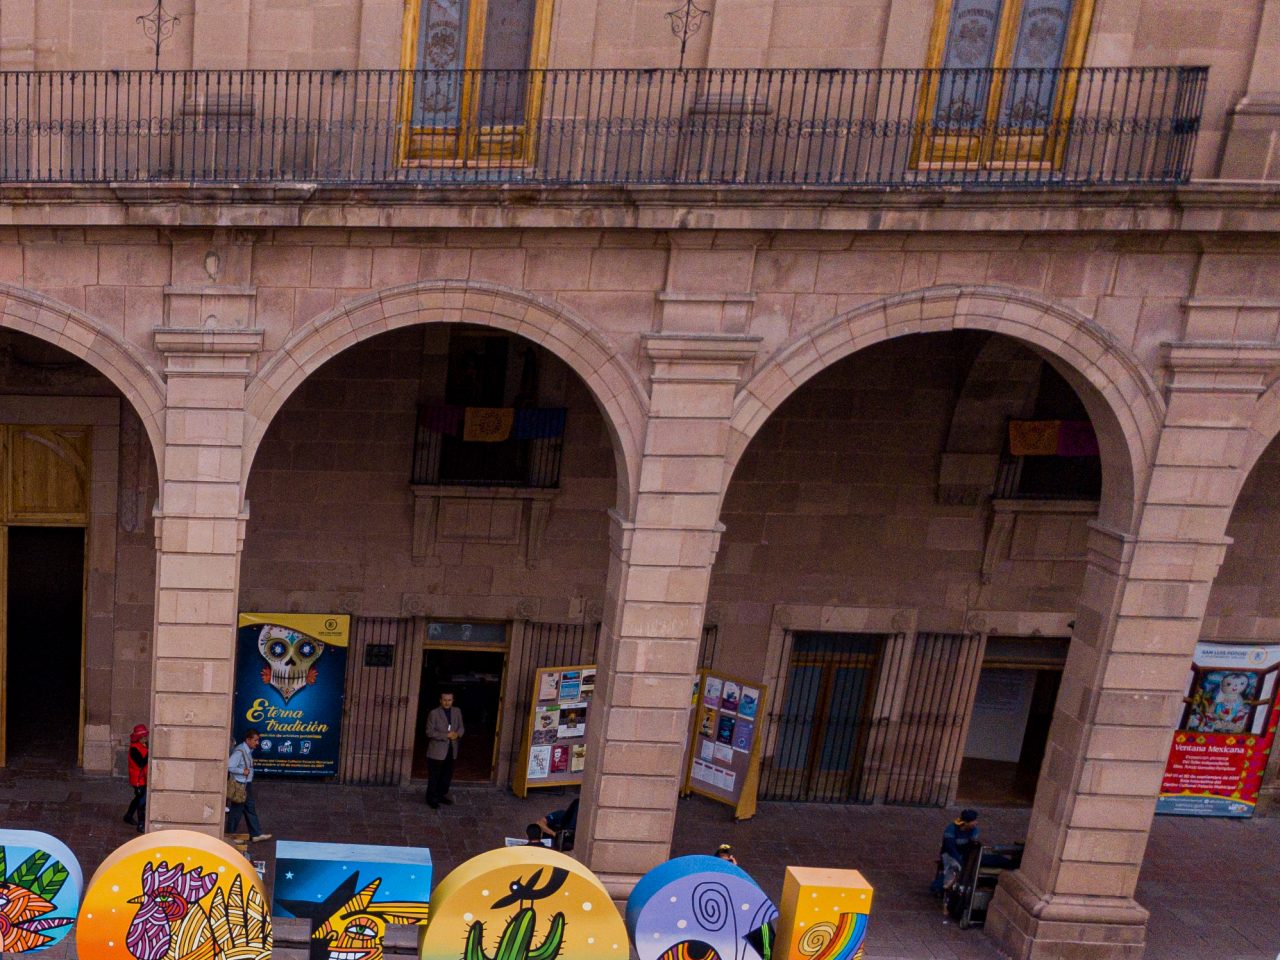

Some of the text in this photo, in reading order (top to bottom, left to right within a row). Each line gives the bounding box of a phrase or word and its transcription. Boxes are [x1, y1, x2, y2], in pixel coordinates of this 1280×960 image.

[245, 697, 304, 723] Eterna
[265, 716, 329, 733] tradición
[1175, 743, 1245, 754] Ventana Mexicana
